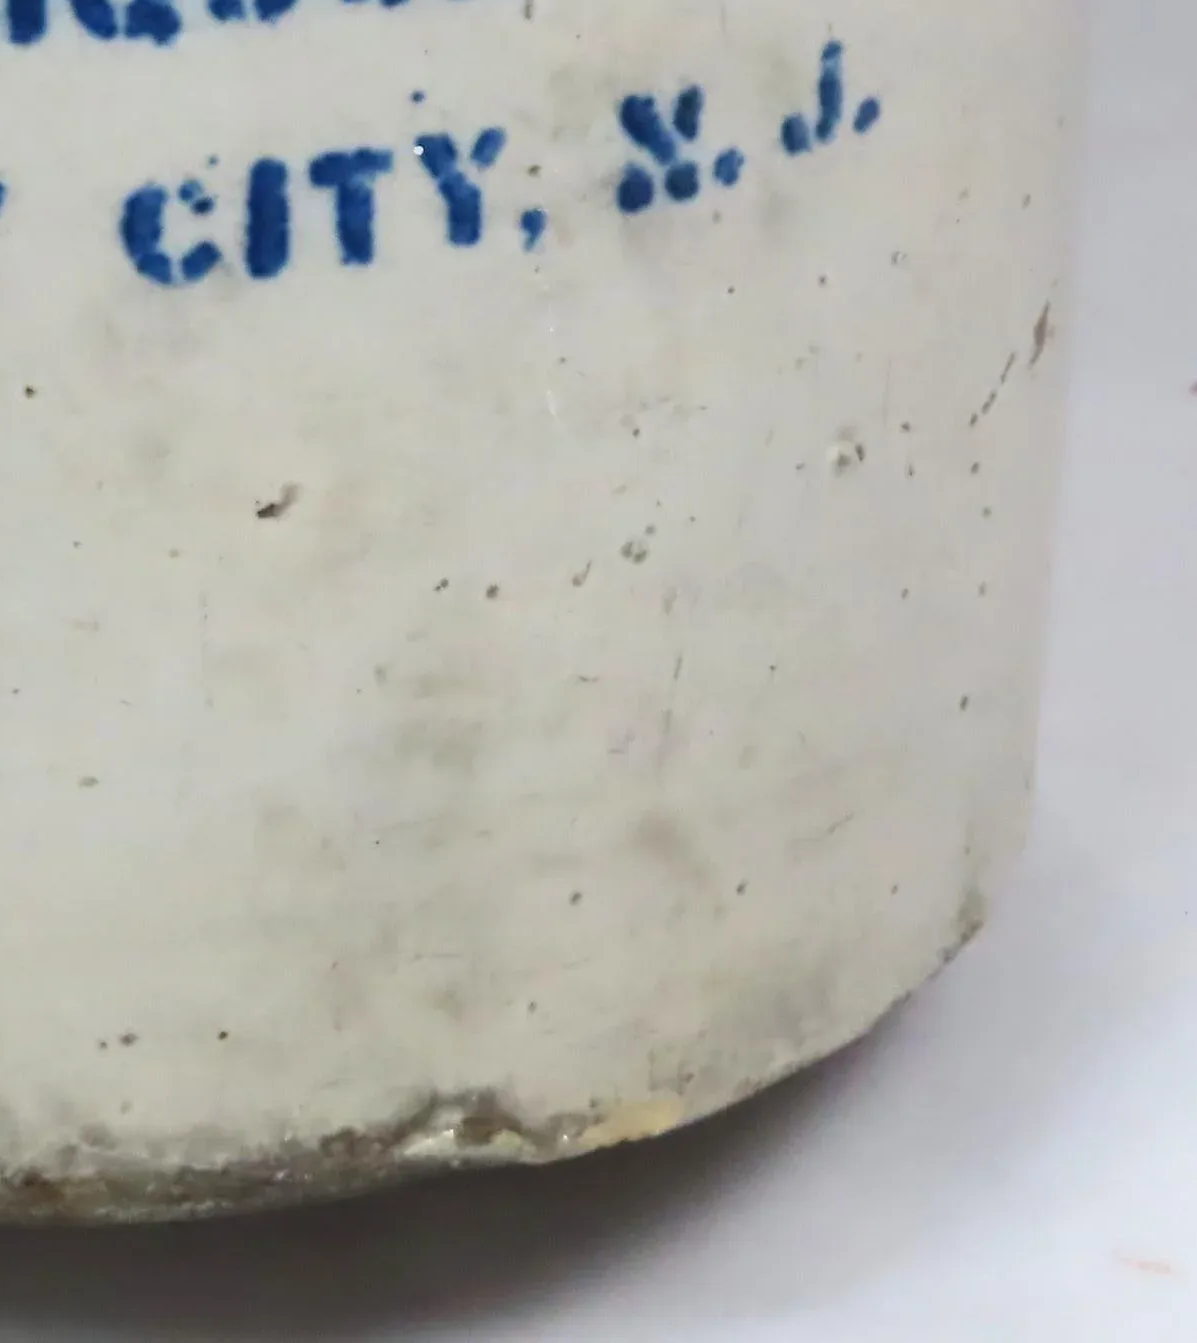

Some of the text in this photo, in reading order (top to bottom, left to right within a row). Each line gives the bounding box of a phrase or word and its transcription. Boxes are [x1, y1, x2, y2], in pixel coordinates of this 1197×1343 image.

[118, 127, 547, 286] CITY,
[616, 86, 746, 214] N.
[780, 40, 881, 156] J.
